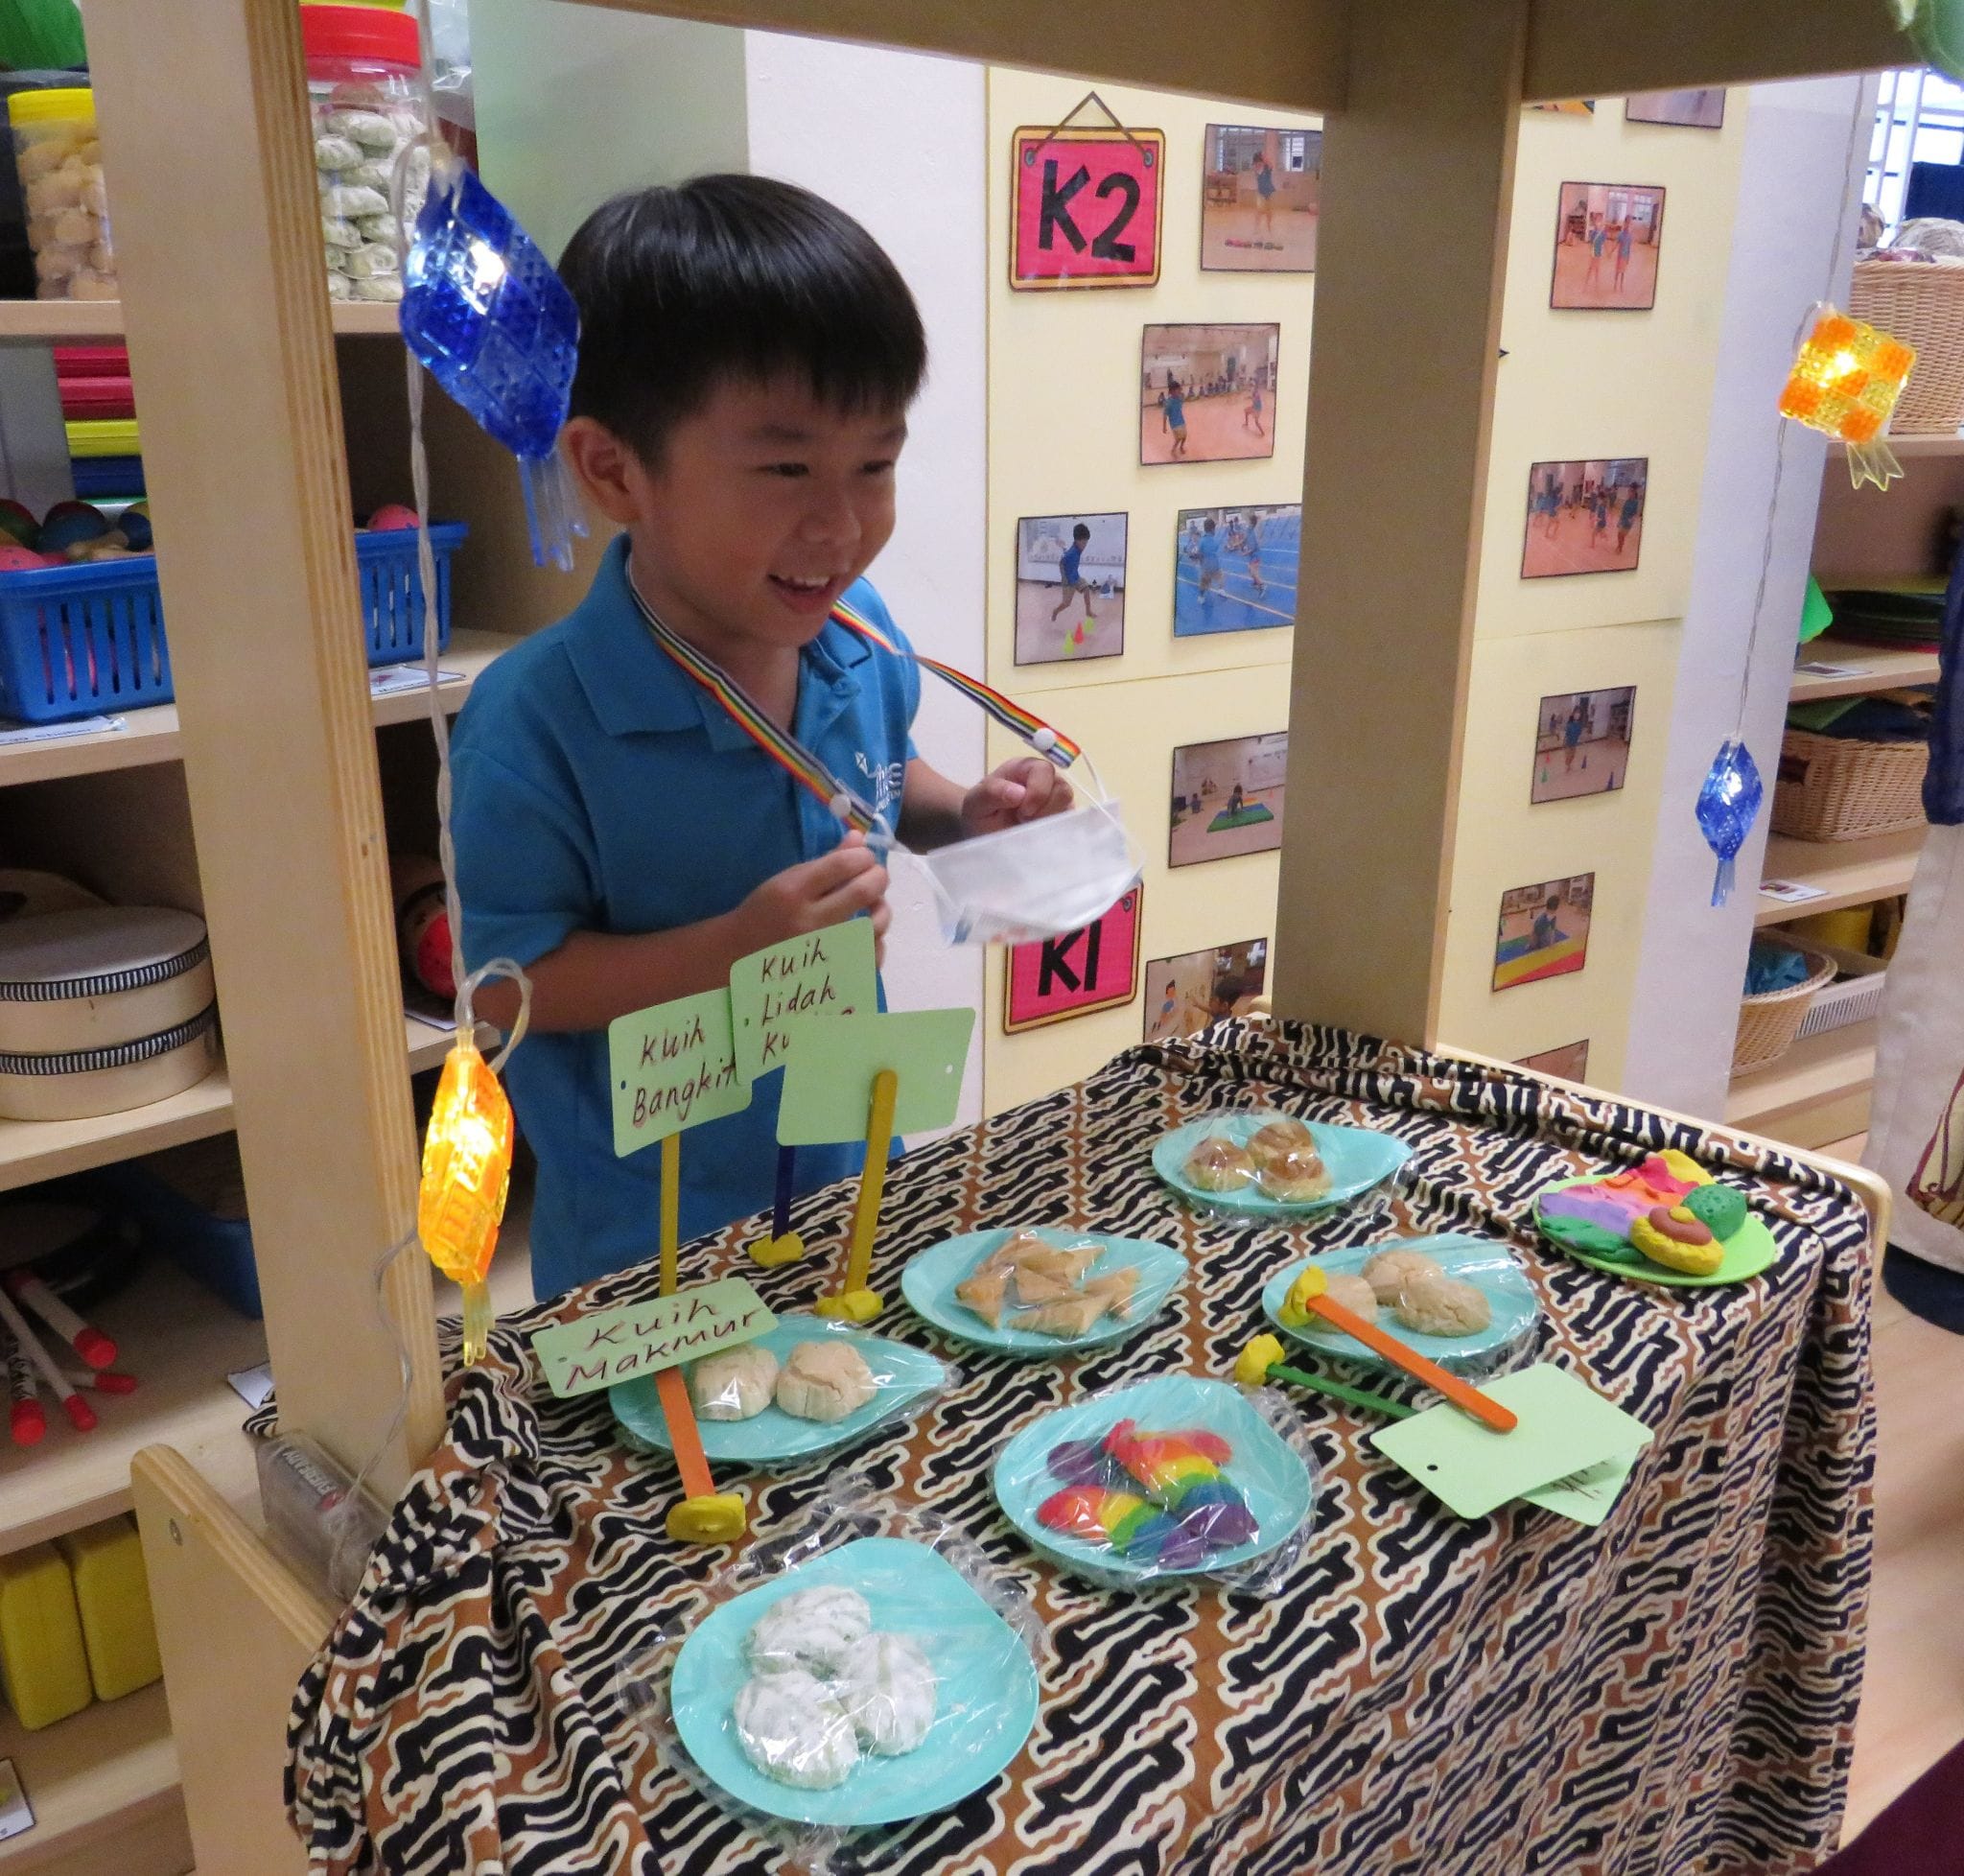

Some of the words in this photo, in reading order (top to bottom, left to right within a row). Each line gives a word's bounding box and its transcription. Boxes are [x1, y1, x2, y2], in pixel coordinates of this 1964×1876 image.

[1039, 159, 1141, 264] K2
[760, 937, 828, 984] Kuih
[761, 975, 837, 1026] Lidah
[640, 1014, 706, 1068] Kuih
[632, 1057, 736, 1129] Bangkit
[565, 1308, 761, 1391] Makmur
[585, 1298, 717, 1349] Kuih
